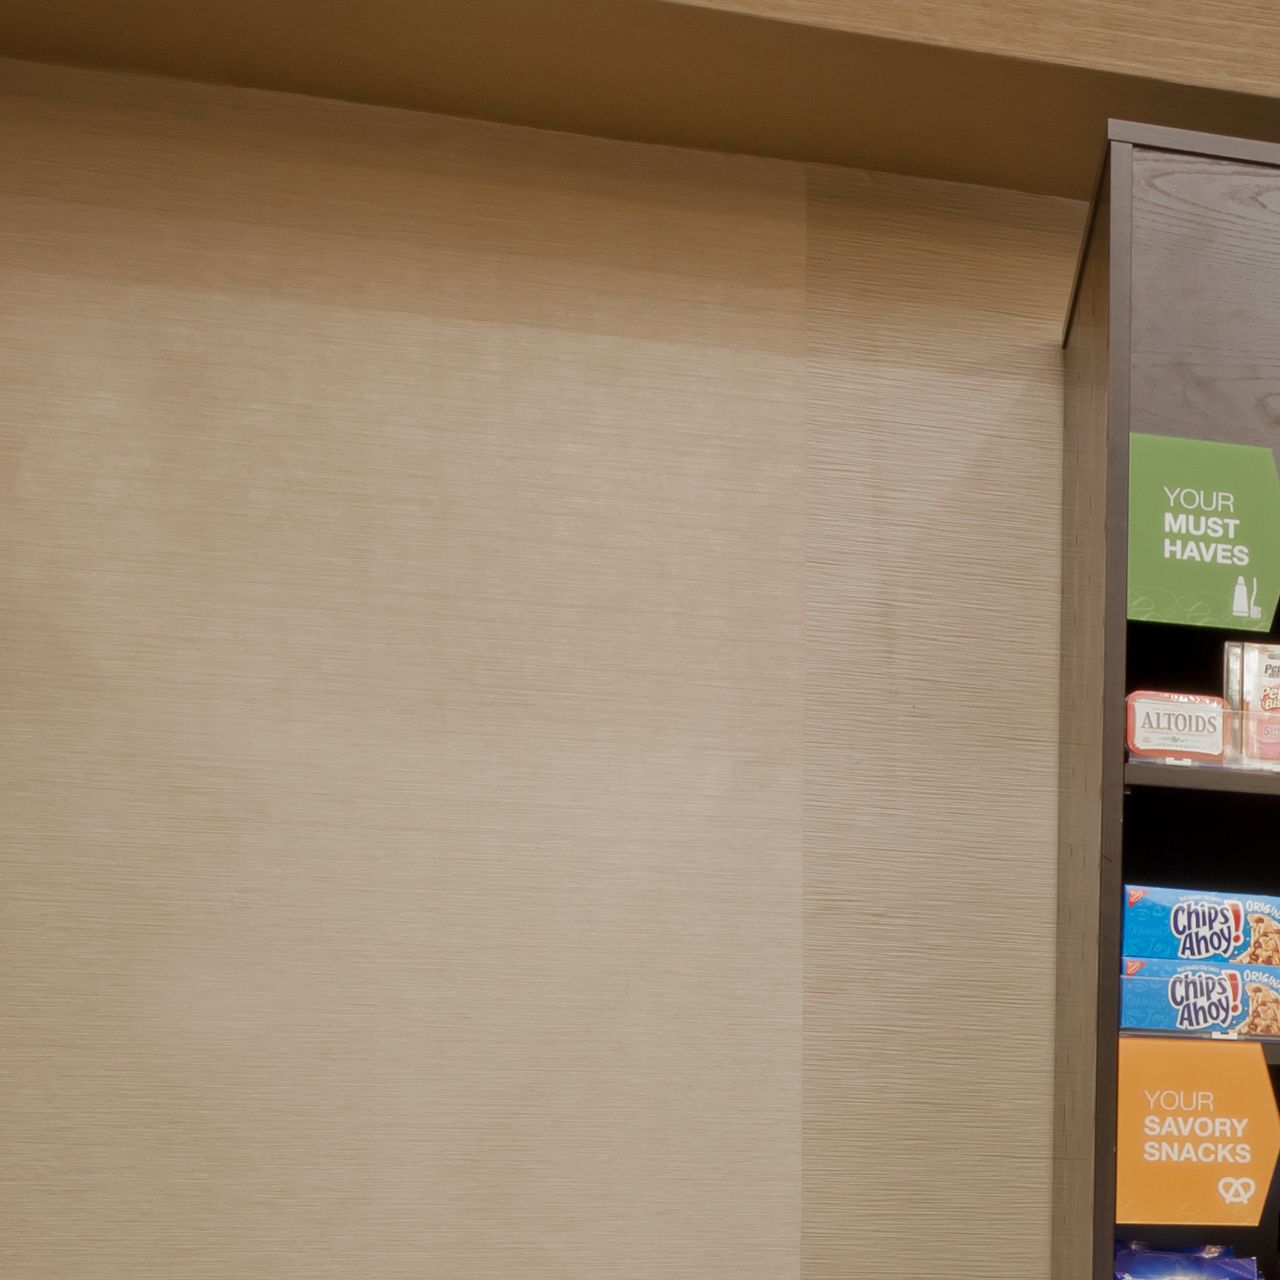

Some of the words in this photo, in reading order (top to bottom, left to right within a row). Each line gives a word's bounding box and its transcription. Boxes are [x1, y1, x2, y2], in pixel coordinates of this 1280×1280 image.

[1163, 486, 1235, 513] YOUR
[1164, 512, 1241, 539] MUST
[1164, 538, 1250, 566] HAVES
[1141, 711, 1217, 734] ALTOIDS
[1172, 901, 1231, 936] Chips
[1170, 971, 1228, 1006] Chips
[1144, 1090, 1214, 1111] YOUR
[1143, 1115, 1248, 1138] SAVORY
[1143, 1141, 1252, 1163] SNACKS
